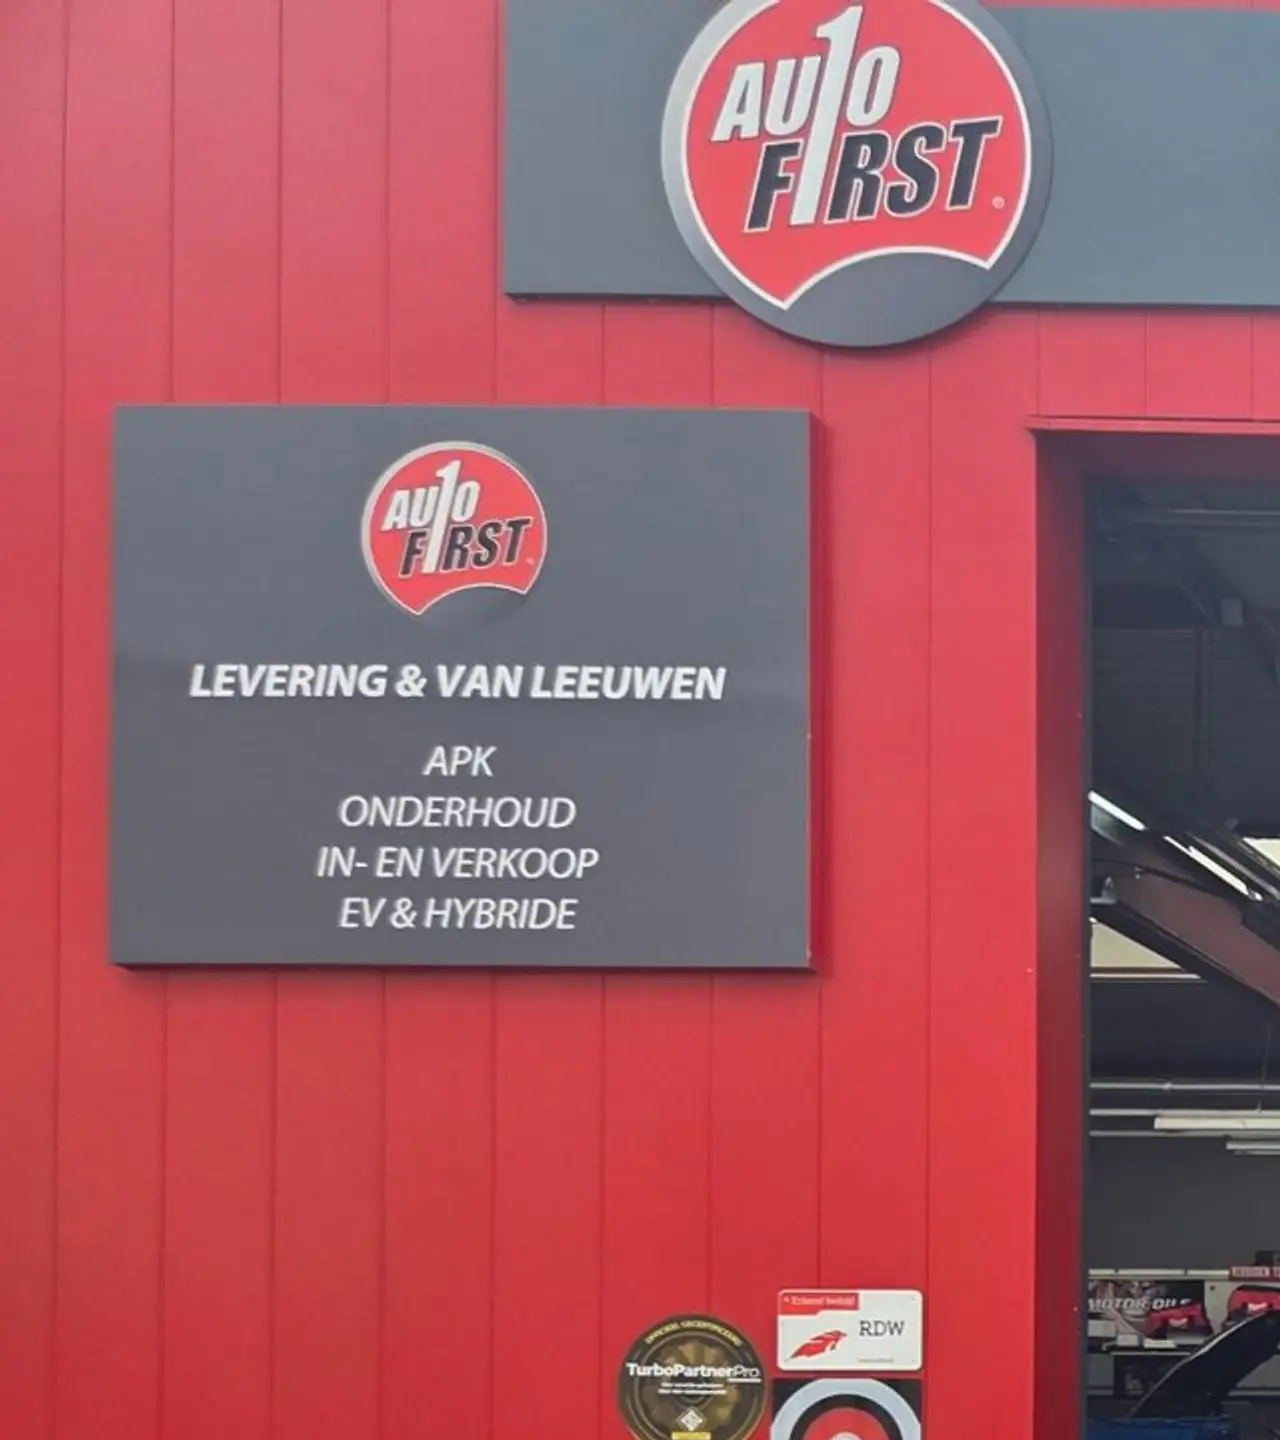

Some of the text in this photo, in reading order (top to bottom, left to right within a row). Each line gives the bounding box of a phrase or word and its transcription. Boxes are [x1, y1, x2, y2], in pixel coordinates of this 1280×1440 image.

[189, 663, 727, 700] LEVERING & VAN LEEUWEN
[422, 745, 497, 777] APK
[338, 795, 576, 828] ONDERHOUD
[316, 845, 600, 879] IN- EN VERKOOP
[339, 897, 578, 929] EV & HYBRIDE
[859, 1320, 905, 1337] RDW
